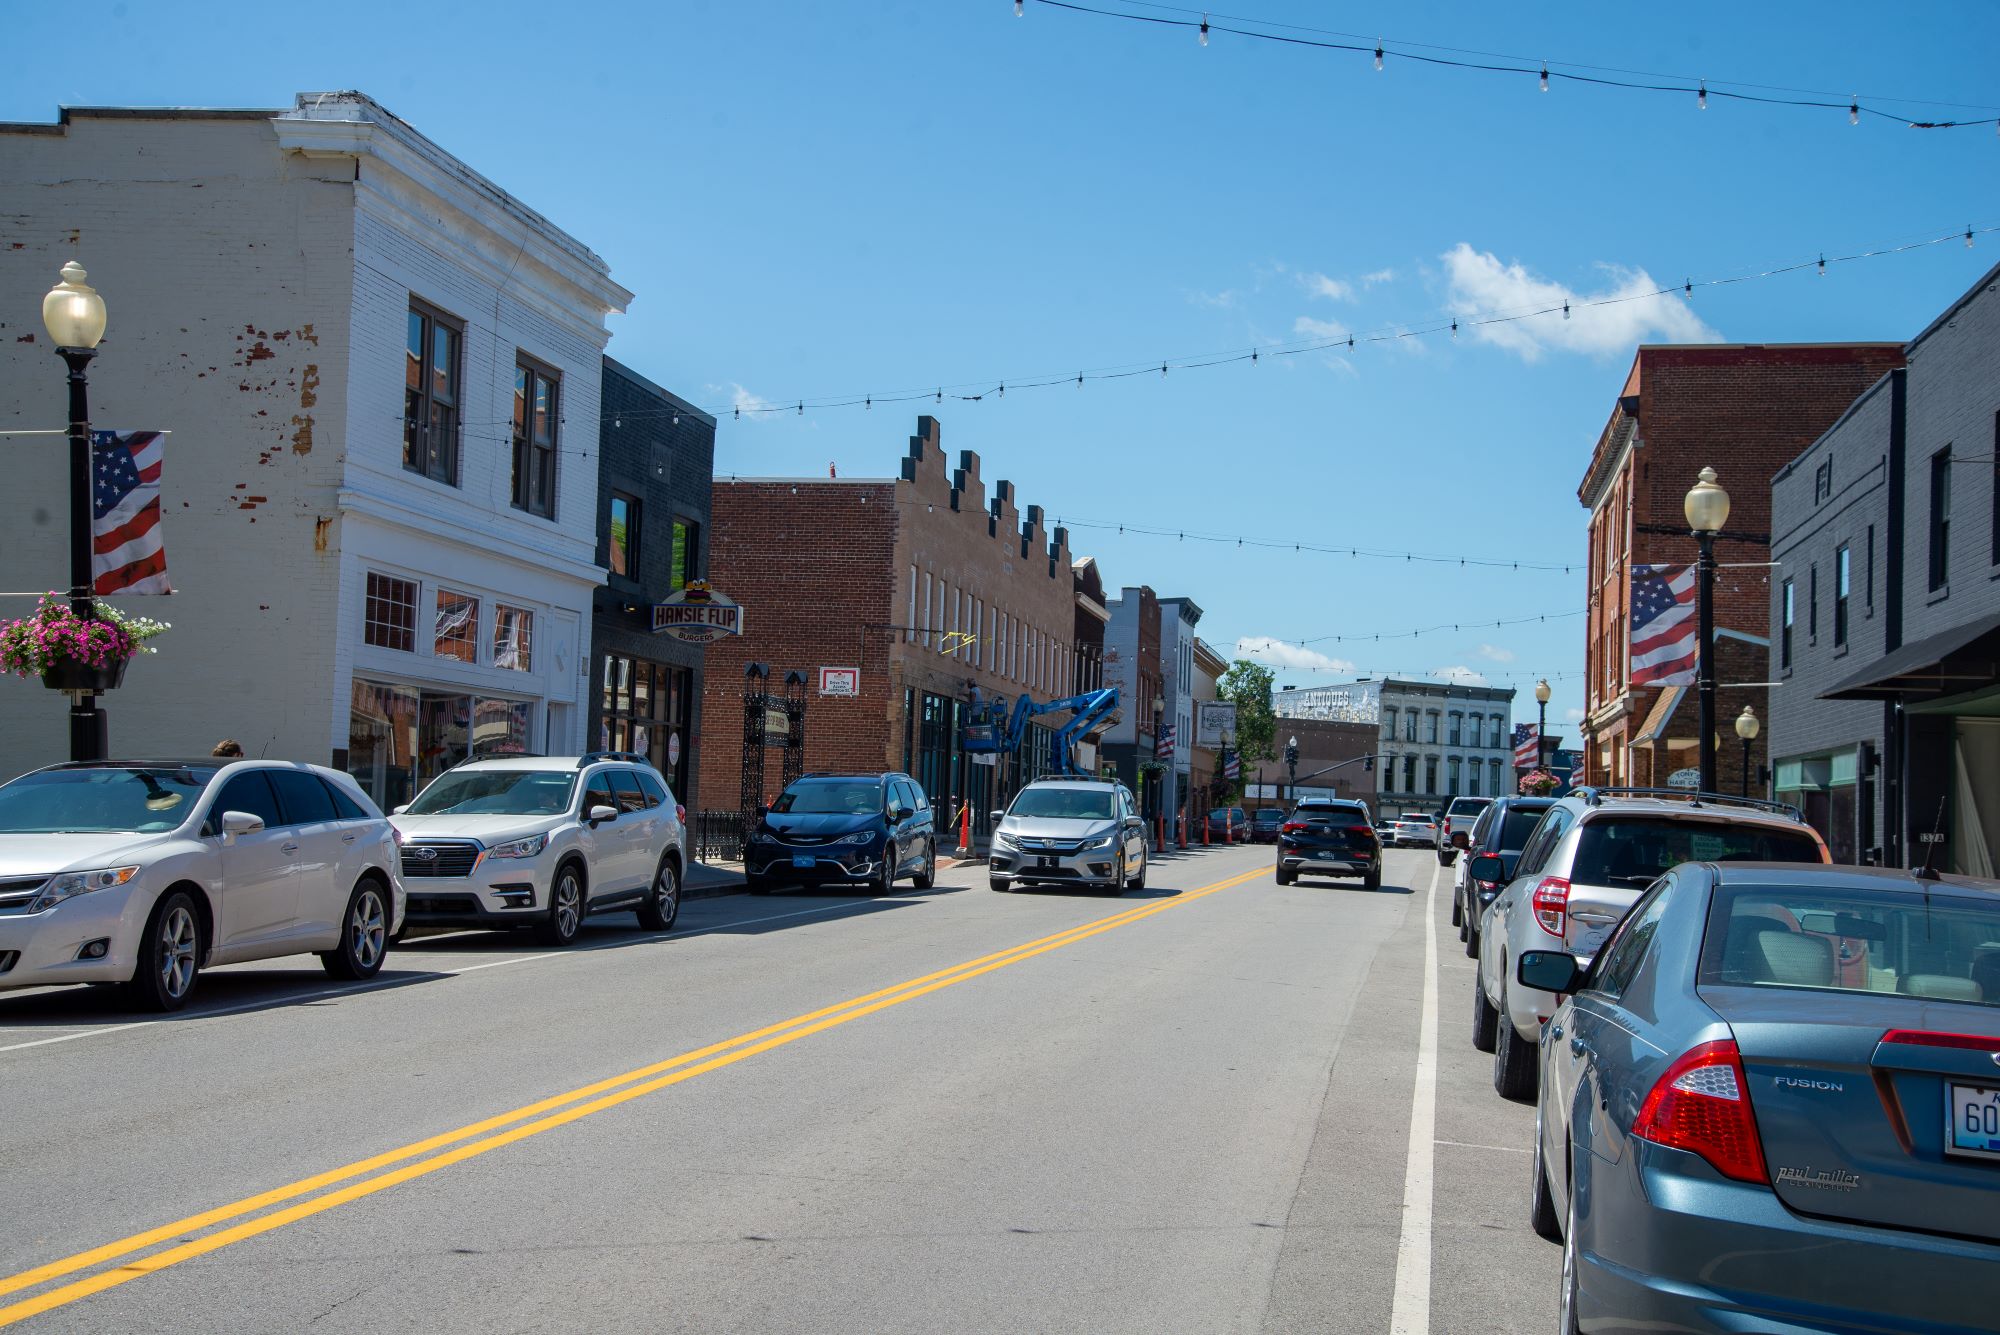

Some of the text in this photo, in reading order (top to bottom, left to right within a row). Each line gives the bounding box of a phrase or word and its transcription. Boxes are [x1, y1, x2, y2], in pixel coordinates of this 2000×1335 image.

[656, 607, 736, 627] HANSIE FLIP
[678, 632, 714, 642] BURGERS
[1304, 691, 1349, 708] ANTIQUES
[1775, 1076, 1843, 1092] FUSION
[1775, 1166, 1860, 1185] paul miller
[1789, 1179, 1851, 1193] LEXINGTON
